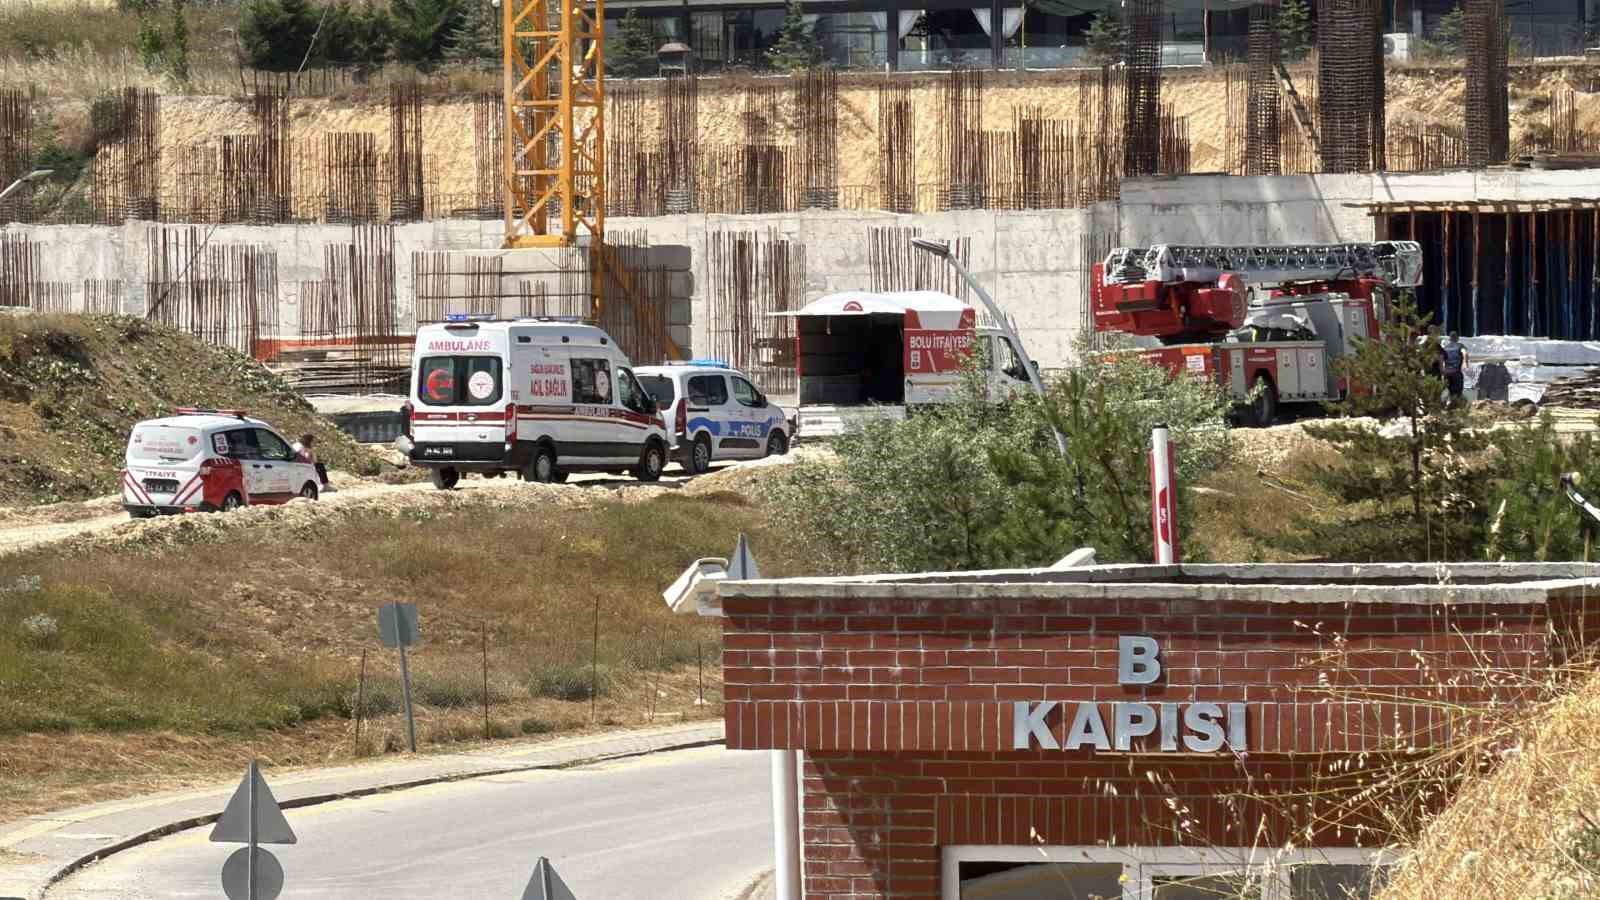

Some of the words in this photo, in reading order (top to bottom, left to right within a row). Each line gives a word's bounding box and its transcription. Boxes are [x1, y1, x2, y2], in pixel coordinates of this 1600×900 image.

[428, 339, 492, 352] AMBULANS
[910, 335, 932, 349] BOLU
[1119, 635, 1161, 684] B
[1013, 700, 1248, 752] KAPISI
